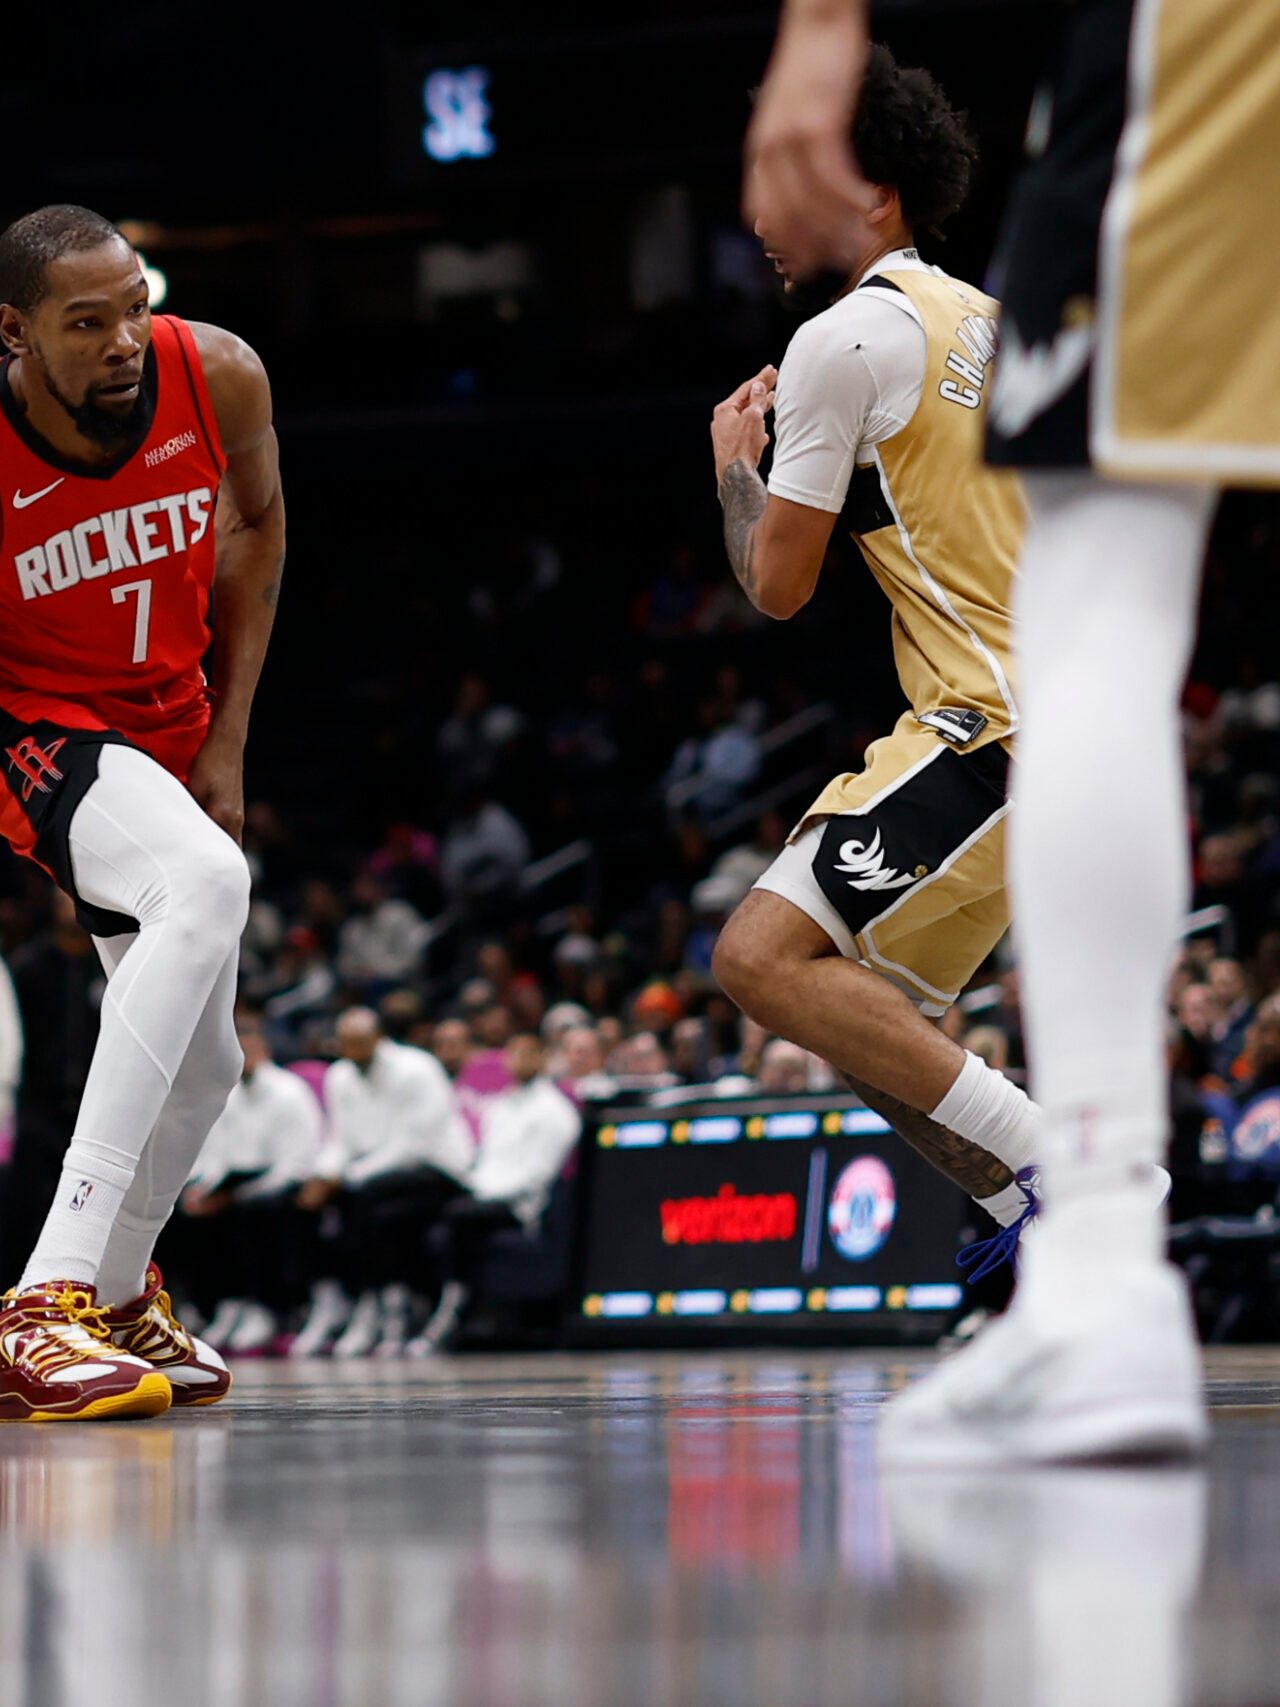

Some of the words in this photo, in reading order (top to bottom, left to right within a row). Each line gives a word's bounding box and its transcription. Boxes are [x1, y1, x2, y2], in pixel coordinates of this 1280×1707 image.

[14, 487, 212, 600] ROCKETS
[110, 578, 152, 664] 7
[660, 1183, 797, 1245] verizon
